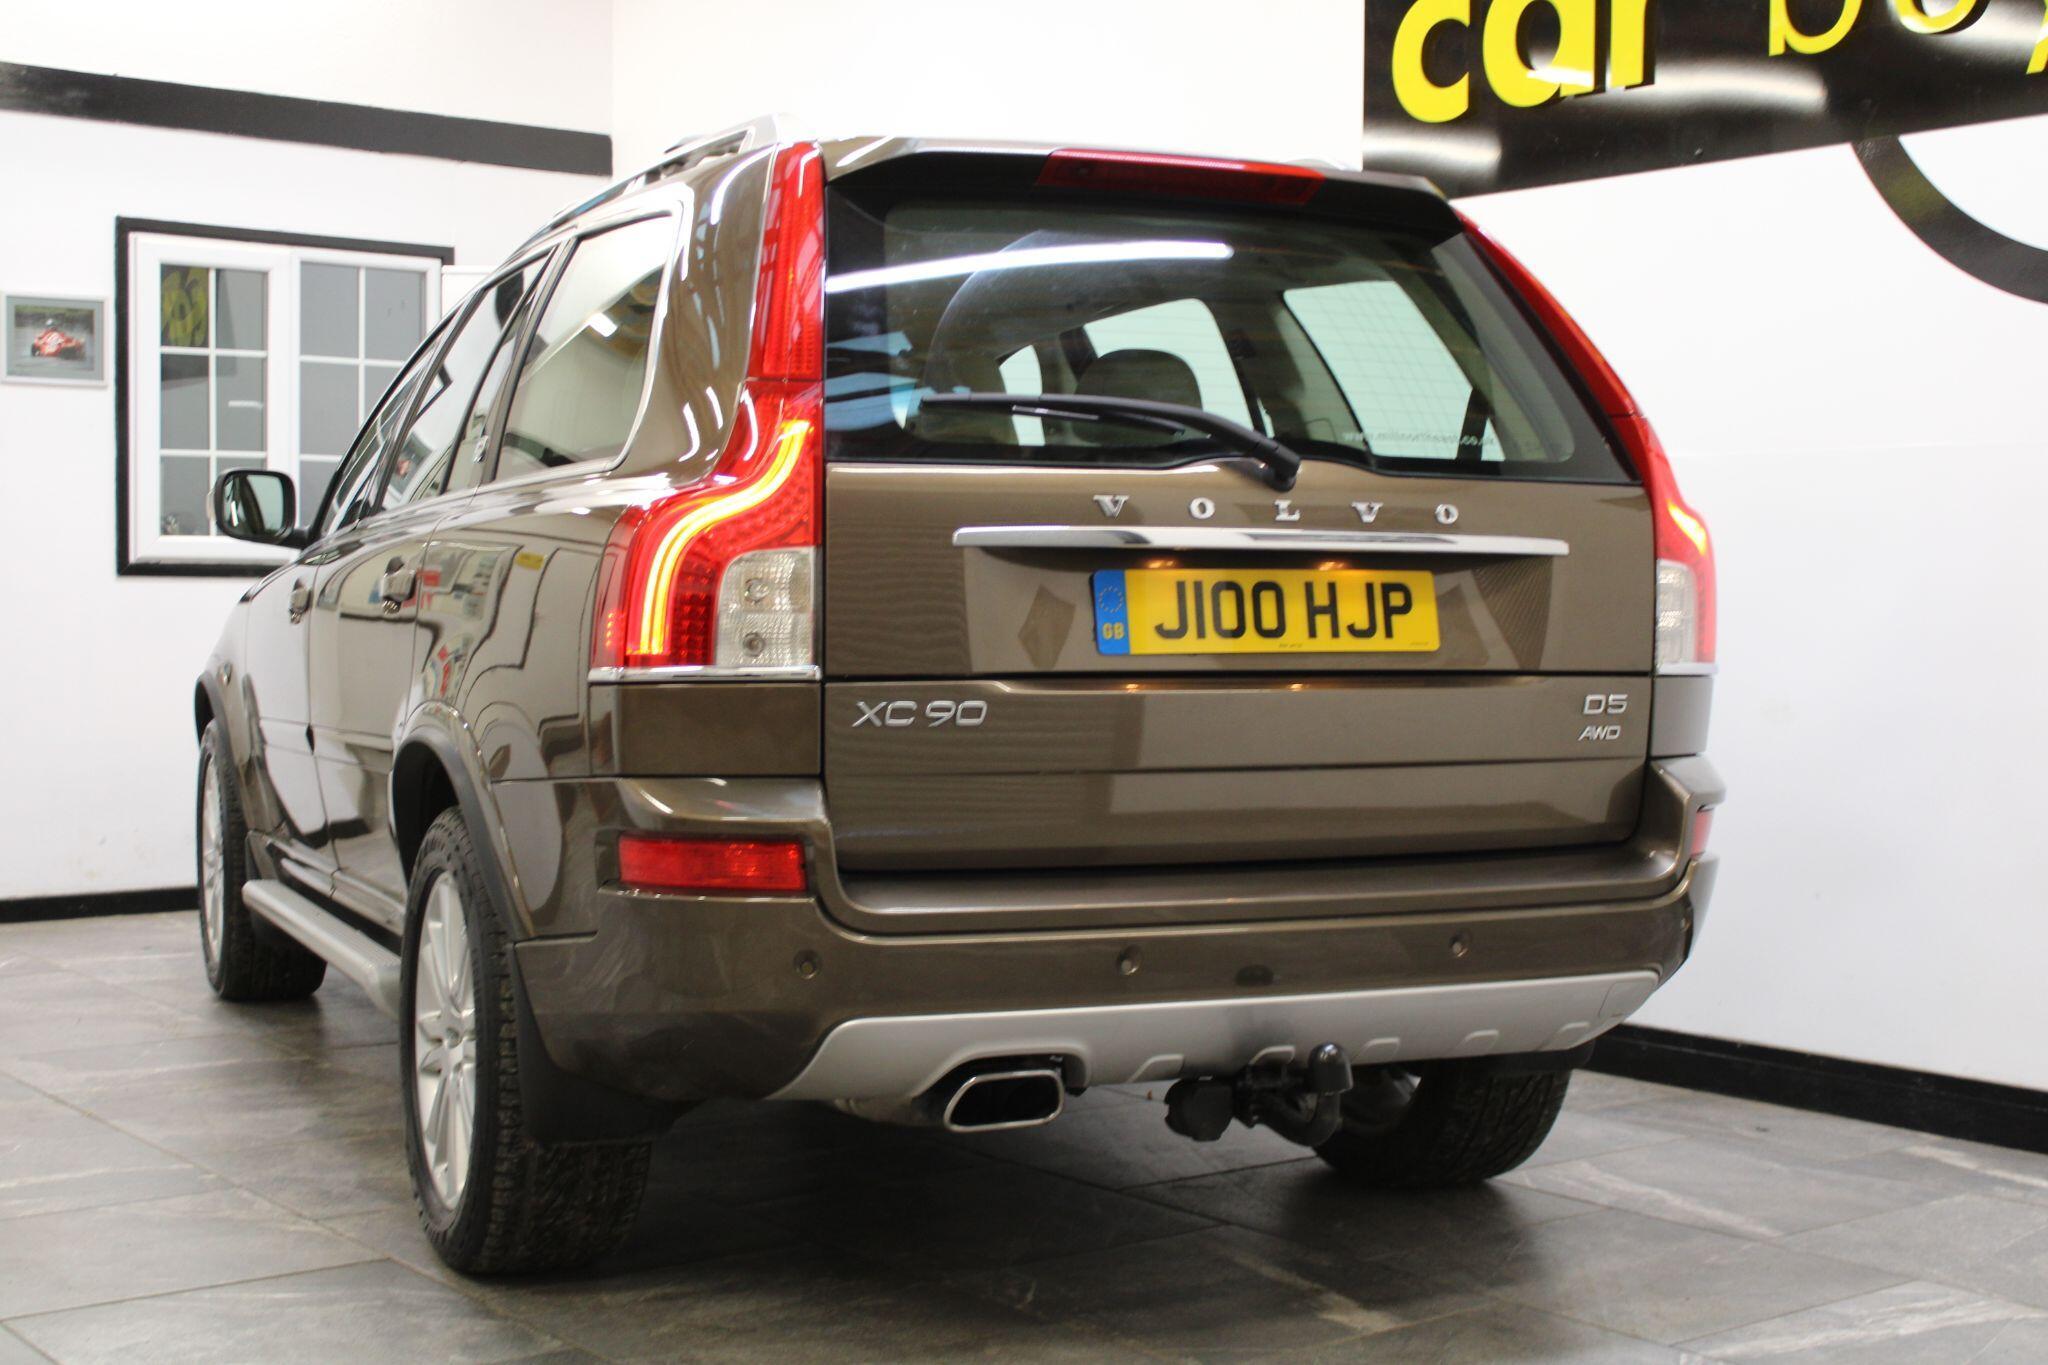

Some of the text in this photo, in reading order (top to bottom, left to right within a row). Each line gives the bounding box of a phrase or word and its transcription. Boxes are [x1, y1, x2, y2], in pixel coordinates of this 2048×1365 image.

[1093, 494, 1459, 525] VOLVO
[1154, 580, 1413, 640] J100 HJP
[1102, 622, 1125, 640] GB
[1583, 694, 1629, 715] D5
[1577, 725, 1622, 741] AWD
